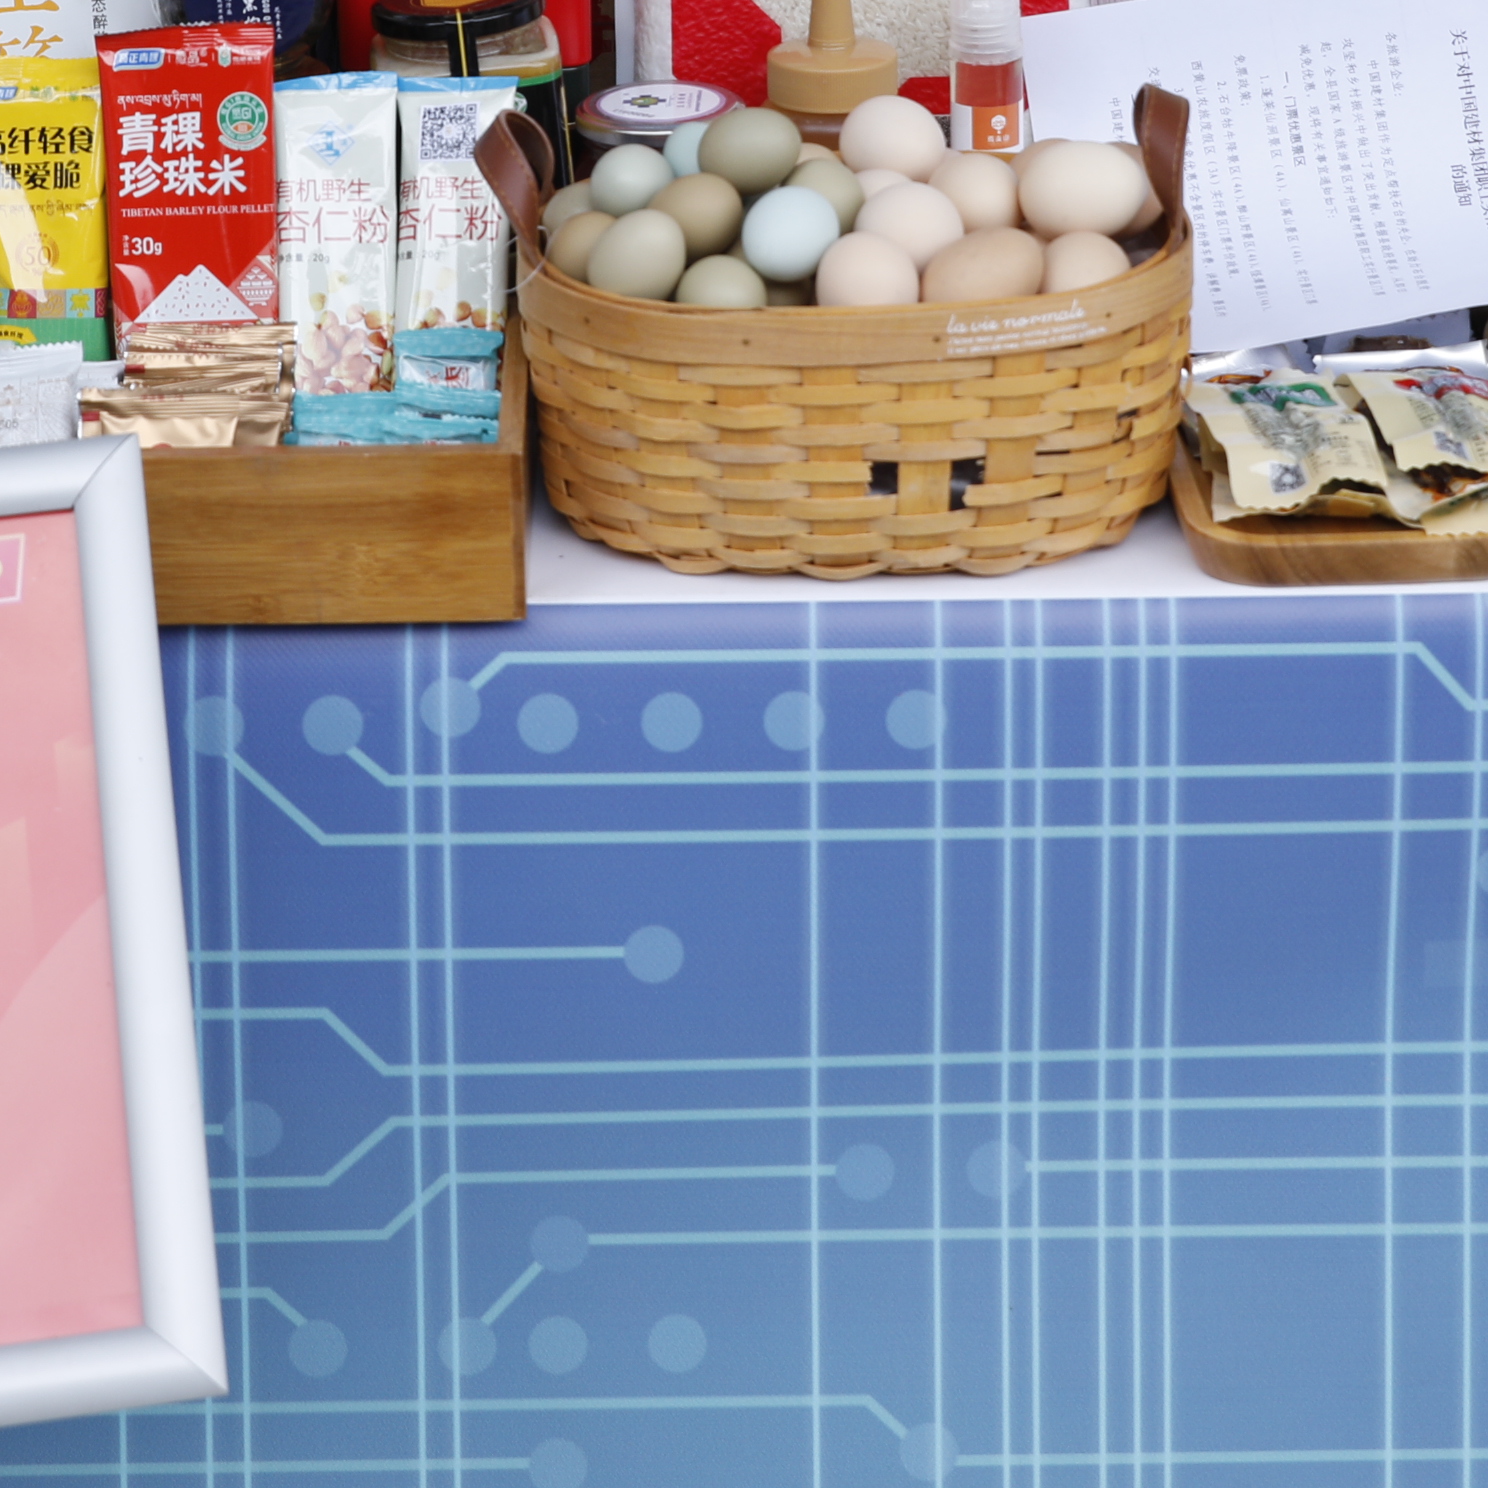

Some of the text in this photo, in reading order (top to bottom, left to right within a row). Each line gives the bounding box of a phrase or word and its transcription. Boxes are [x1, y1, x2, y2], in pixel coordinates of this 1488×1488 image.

[118, 111, 205, 156] 青稞
[118, 153, 247, 199] 珍珠米
[275, 178, 372, 203] 有机野生
[1450, 164, 1473, 207] 的通知
[121, 204, 275, 218] TIBETAN BARLEY FLOUR PELLET
[276, 206, 390, 244] 杏仁粉
[398, 204, 502, 242] 杏仁粉
[131, 236, 162, 256] 30g
